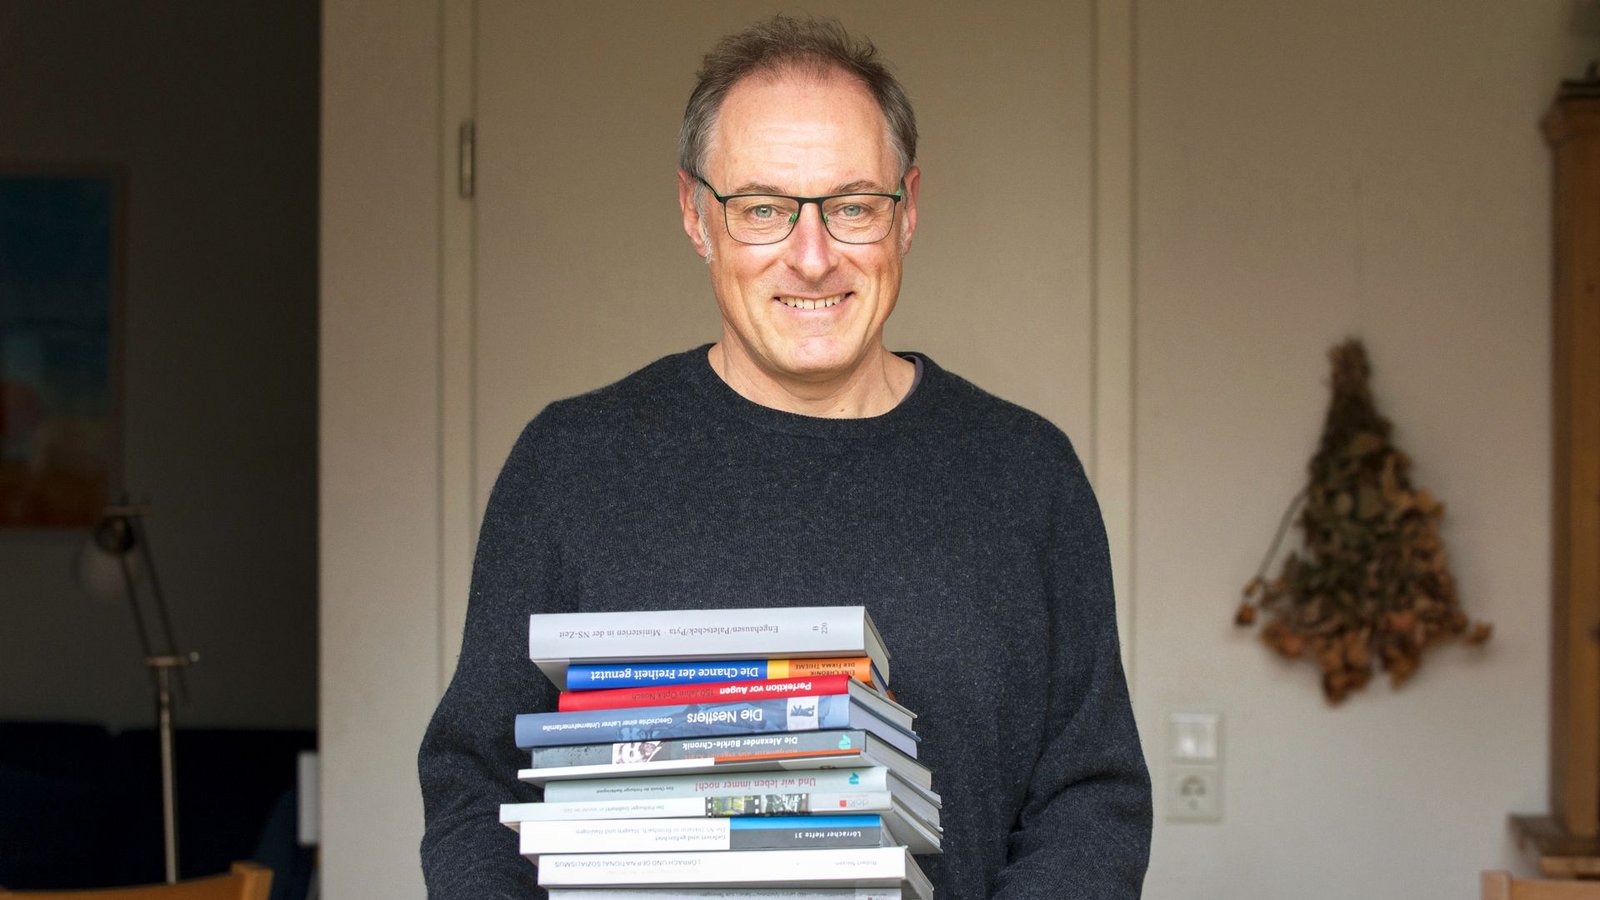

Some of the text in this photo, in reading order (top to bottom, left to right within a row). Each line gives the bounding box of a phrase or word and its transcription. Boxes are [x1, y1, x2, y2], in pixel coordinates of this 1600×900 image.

[559, 631, 590, 639] NS-Zeit
[617, 628, 661, 637] Ministerien
[669, 625, 779, 637] Engehausen/Paletschek/Pyta
[590, 667, 759, 680] Die Chance der Freiheit genutzt
[719, 684, 748, 695] Augen
[764, 682, 812, 693] Perfektion
[638, 717, 672, 726] Geschichte
[686, 708, 763, 724] Die Nestlers
[542, 721, 600, 732] Unternehmerfamilie
[601, 720, 621, 728] Lahrer
[682, 736, 798, 750] Die Alexander Bürkle-Chronik
[695, 778, 816, 792] Und wir leben immer noch!
[826, 830, 861, 839] Lörracher
